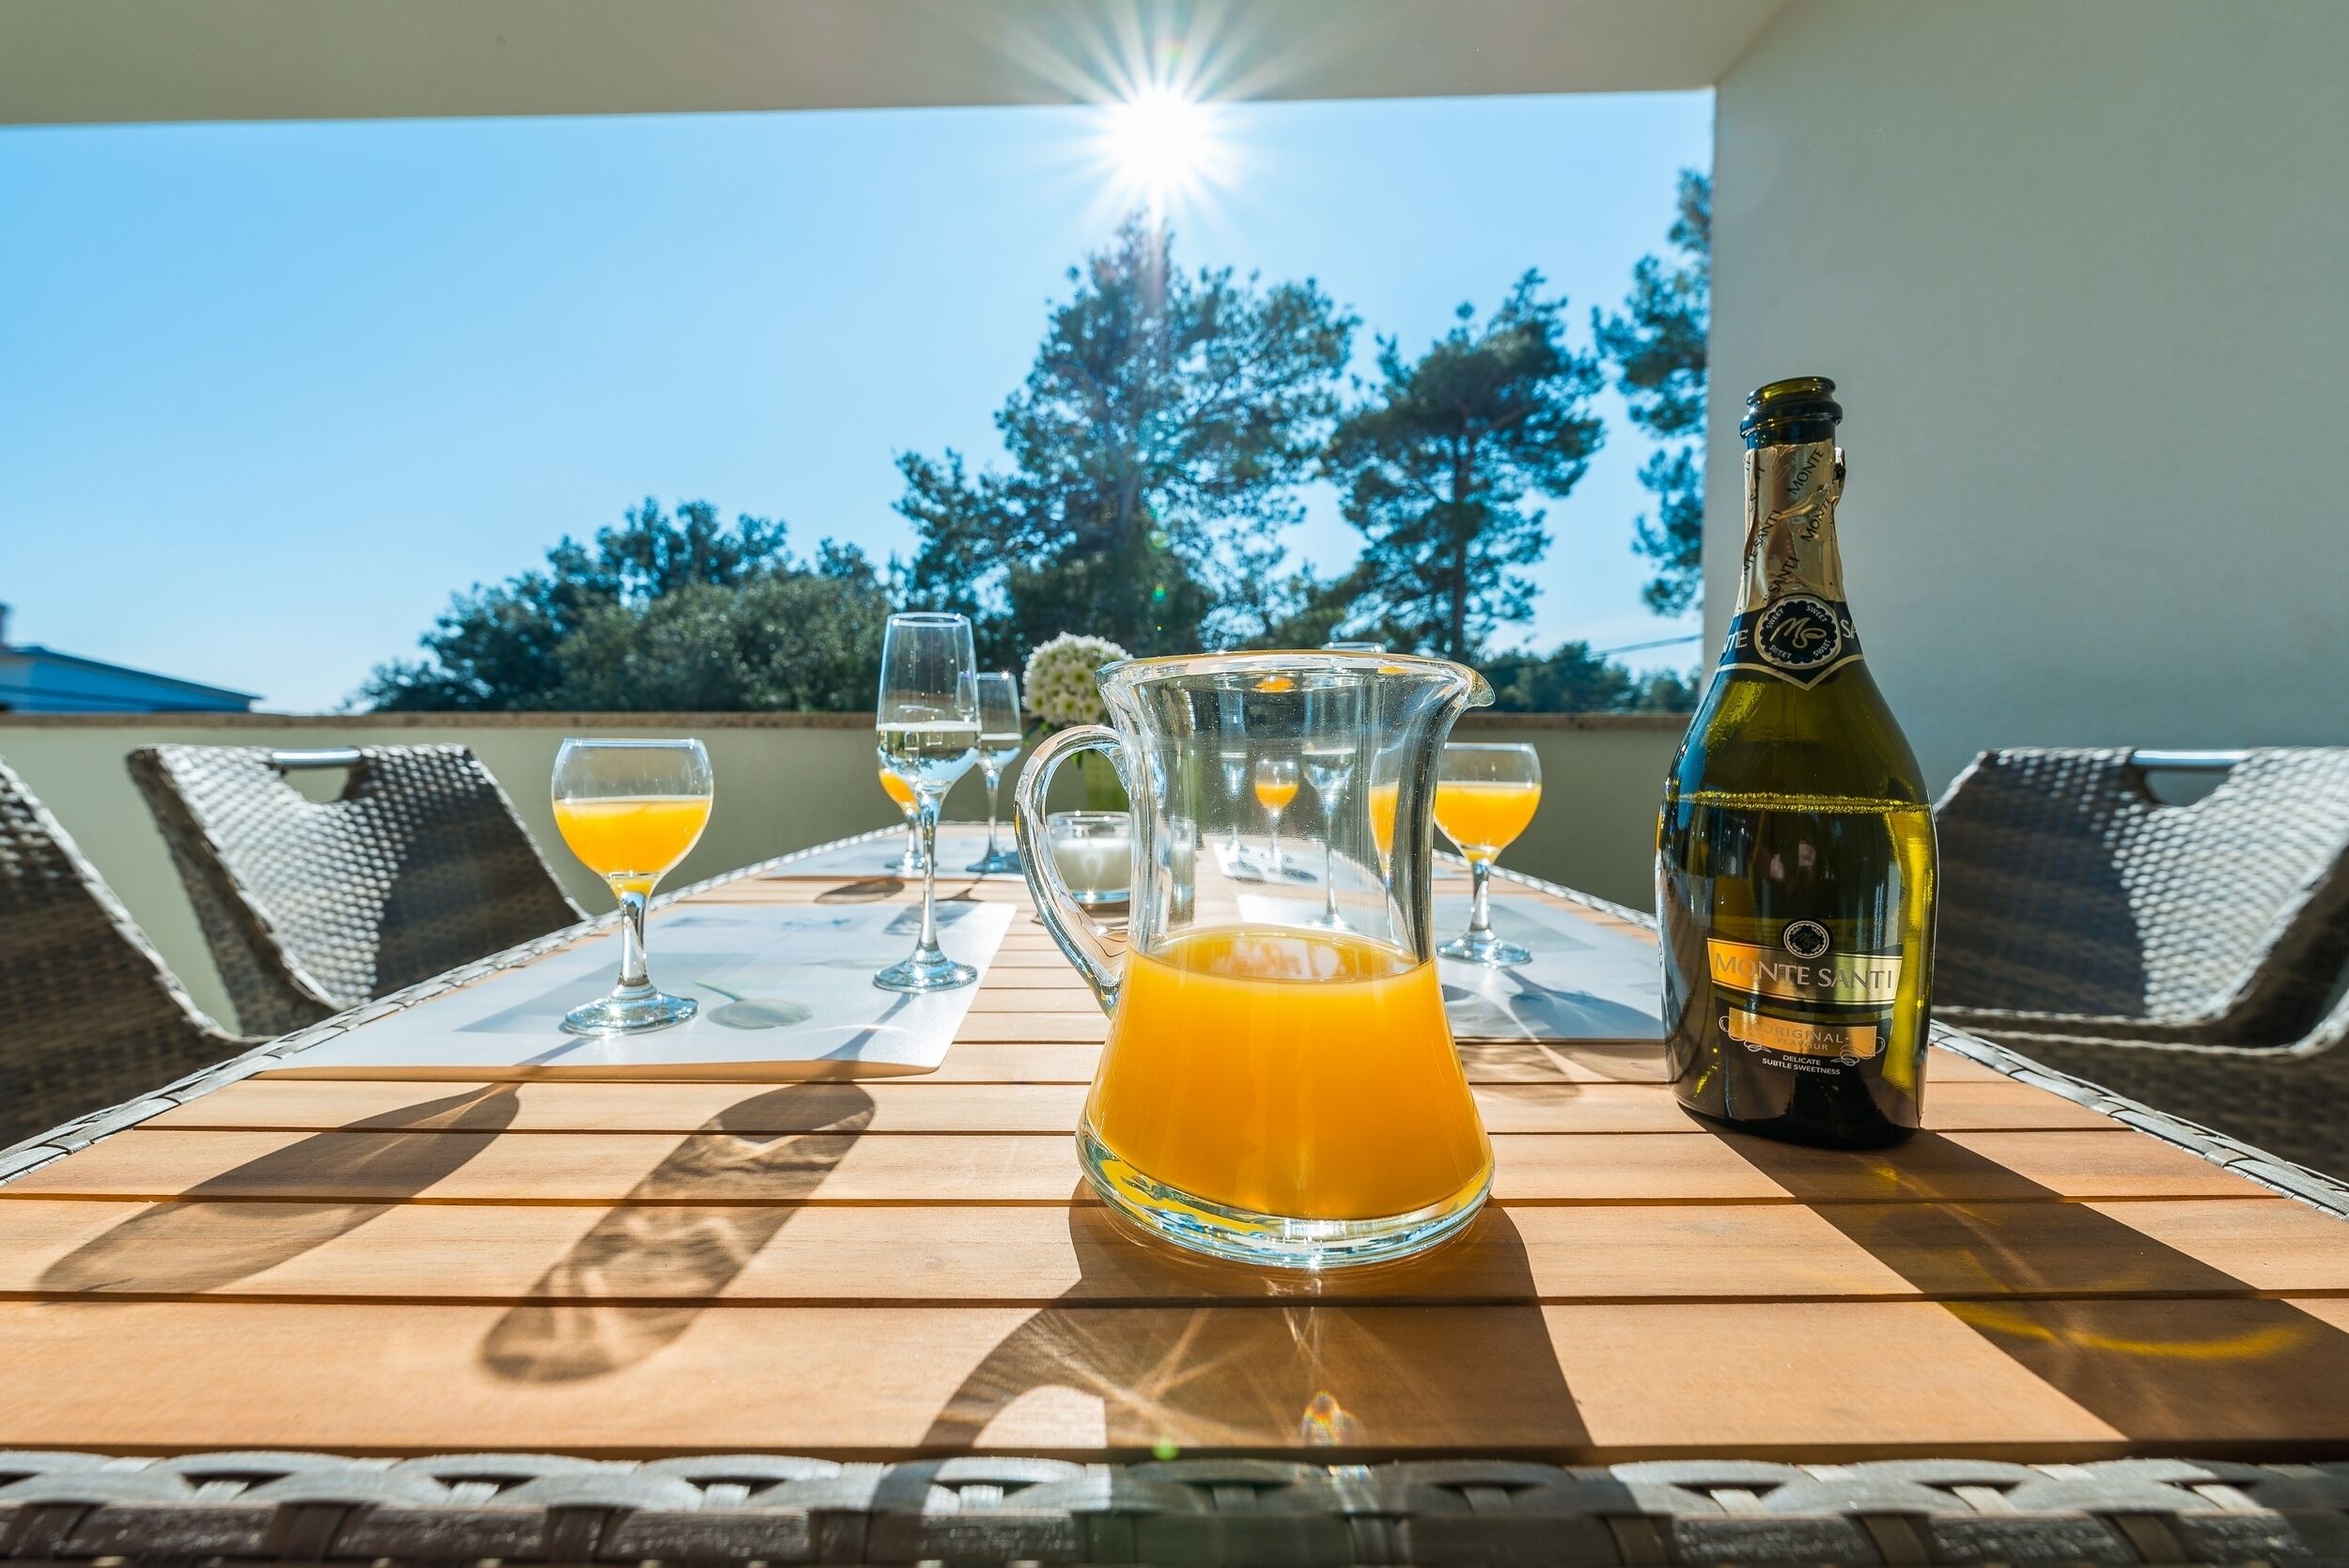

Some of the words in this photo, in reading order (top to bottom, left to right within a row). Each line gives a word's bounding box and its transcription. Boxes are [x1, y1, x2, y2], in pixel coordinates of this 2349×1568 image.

[1787, 448, 1824, 495] MONTE
[1754, 509, 1782, 548] SANTI
[1800, 495, 1831, 542] MONTE
[1767, 556, 1799, 594] SANTI
[1766, 608, 1784, 629] SWEET
[1805, 604, 1828, 623] SWEET
[1768, 644, 1793, 660] SWEET
[1812, 640, 1831, 657] SWEET
[1715, 952, 1810, 986] MONTE
[1817, 967, 1892, 989] SANTI
[1764, 1024, 1843, 1044] ORIGINAL
[1762, 1058, 1792, 1069] SUBTLE
[1794, 1063, 1841, 1076] SWEETNESS
[1782, 1054, 1821, 1066] DELICATE
